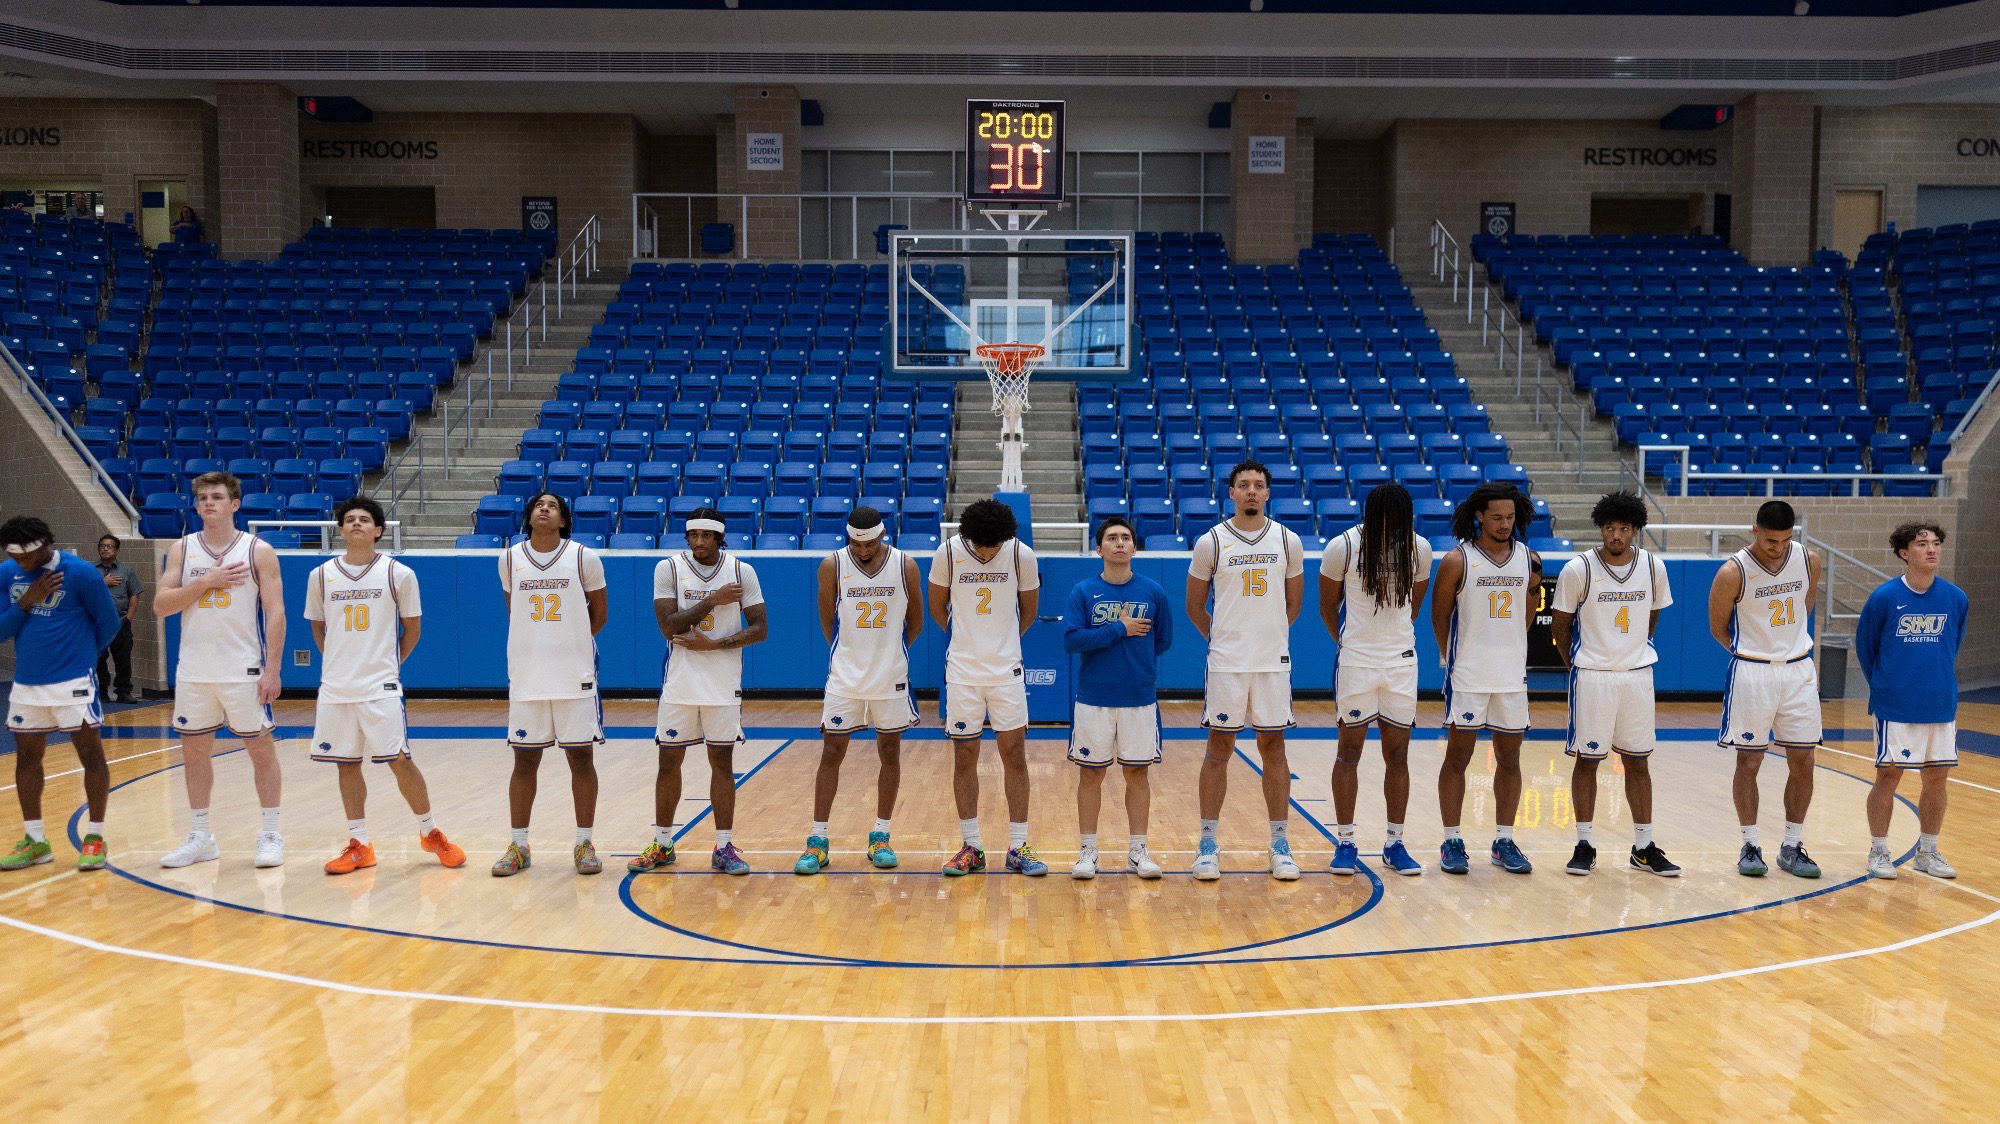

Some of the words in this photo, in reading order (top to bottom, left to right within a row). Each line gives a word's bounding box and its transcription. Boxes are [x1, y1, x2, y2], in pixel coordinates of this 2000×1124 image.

[0, 127, 61, 147] IONS
[978, 112, 1053, 139] 20:00
[302, 140, 439, 160] RESTROOMS
[749, 147, 781, 155] STUDENT
[753, 138, 776, 146] HOME
[1250, 150, 1283, 158] STUDENT
[1255, 141, 1278, 149] HOME
[749, 157, 781, 165] SECTION
[989, 142, 1043, 190] 30
[1251, 160, 1283, 168] SECTION
[1583, 147, 1718, 166] RESTROOMS
[1241, 568, 1268, 597] 15
[199, 584, 232, 609] 25
[529, 593, 562, 623] 32
[975, 587, 992, 616] 2
[1488, 591, 1513, 619] 12
[344, 603, 370, 632] 10
[856, 601, 888, 629] 22
[1536, 615, 1553, 625] PER
[1615, 605, 1630, 634] 4
[1768, 596, 1796, 628] 21
